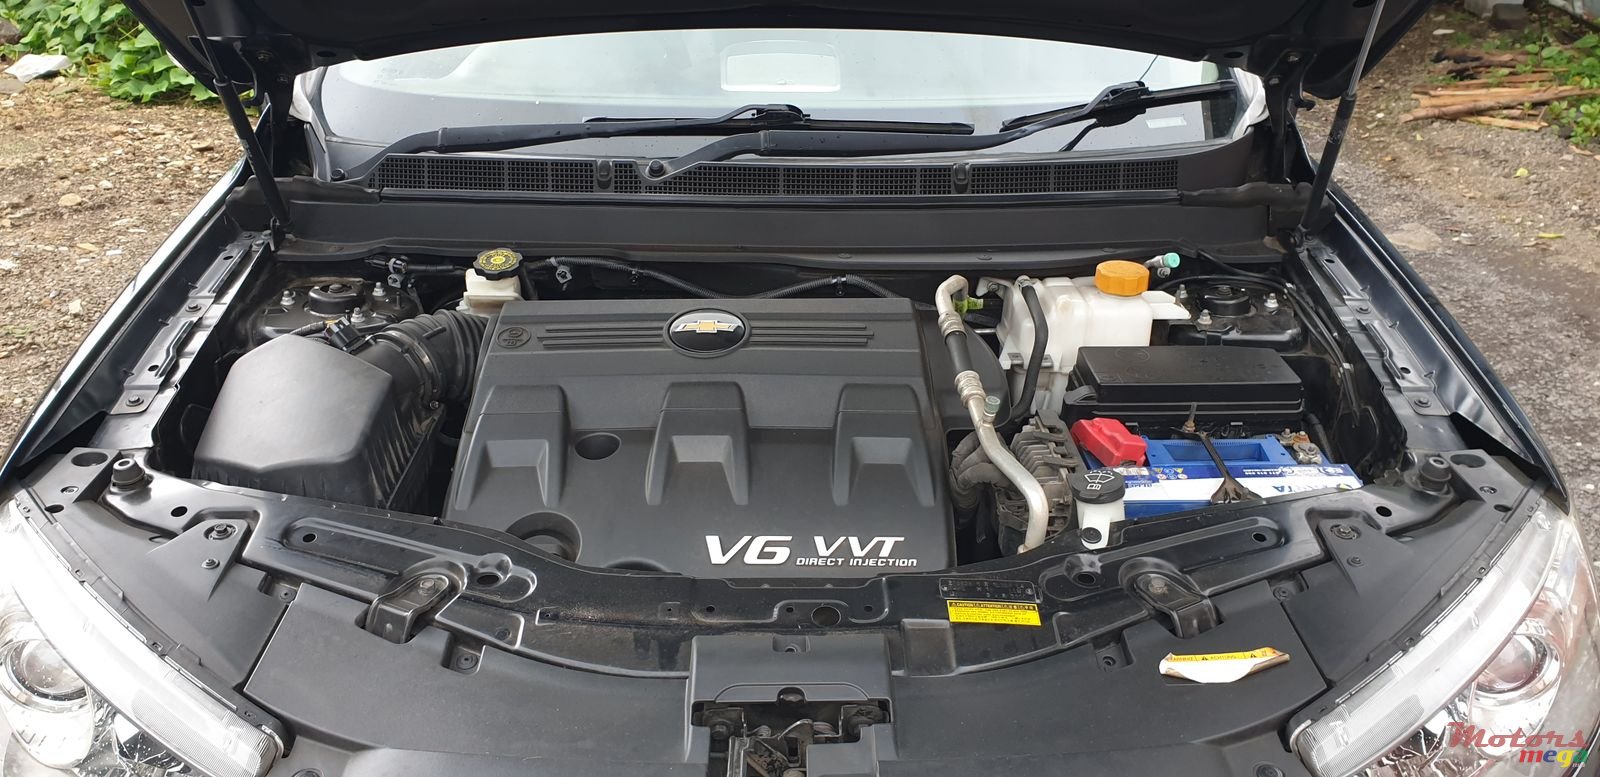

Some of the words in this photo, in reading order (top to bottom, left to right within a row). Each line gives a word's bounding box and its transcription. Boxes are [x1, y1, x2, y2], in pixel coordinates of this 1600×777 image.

[705, 535, 793, 565] V6
[813, 535, 905, 558] VVT
[796, 557, 845, 567] DIRECT
[849, 558, 918, 567] INJECTION
